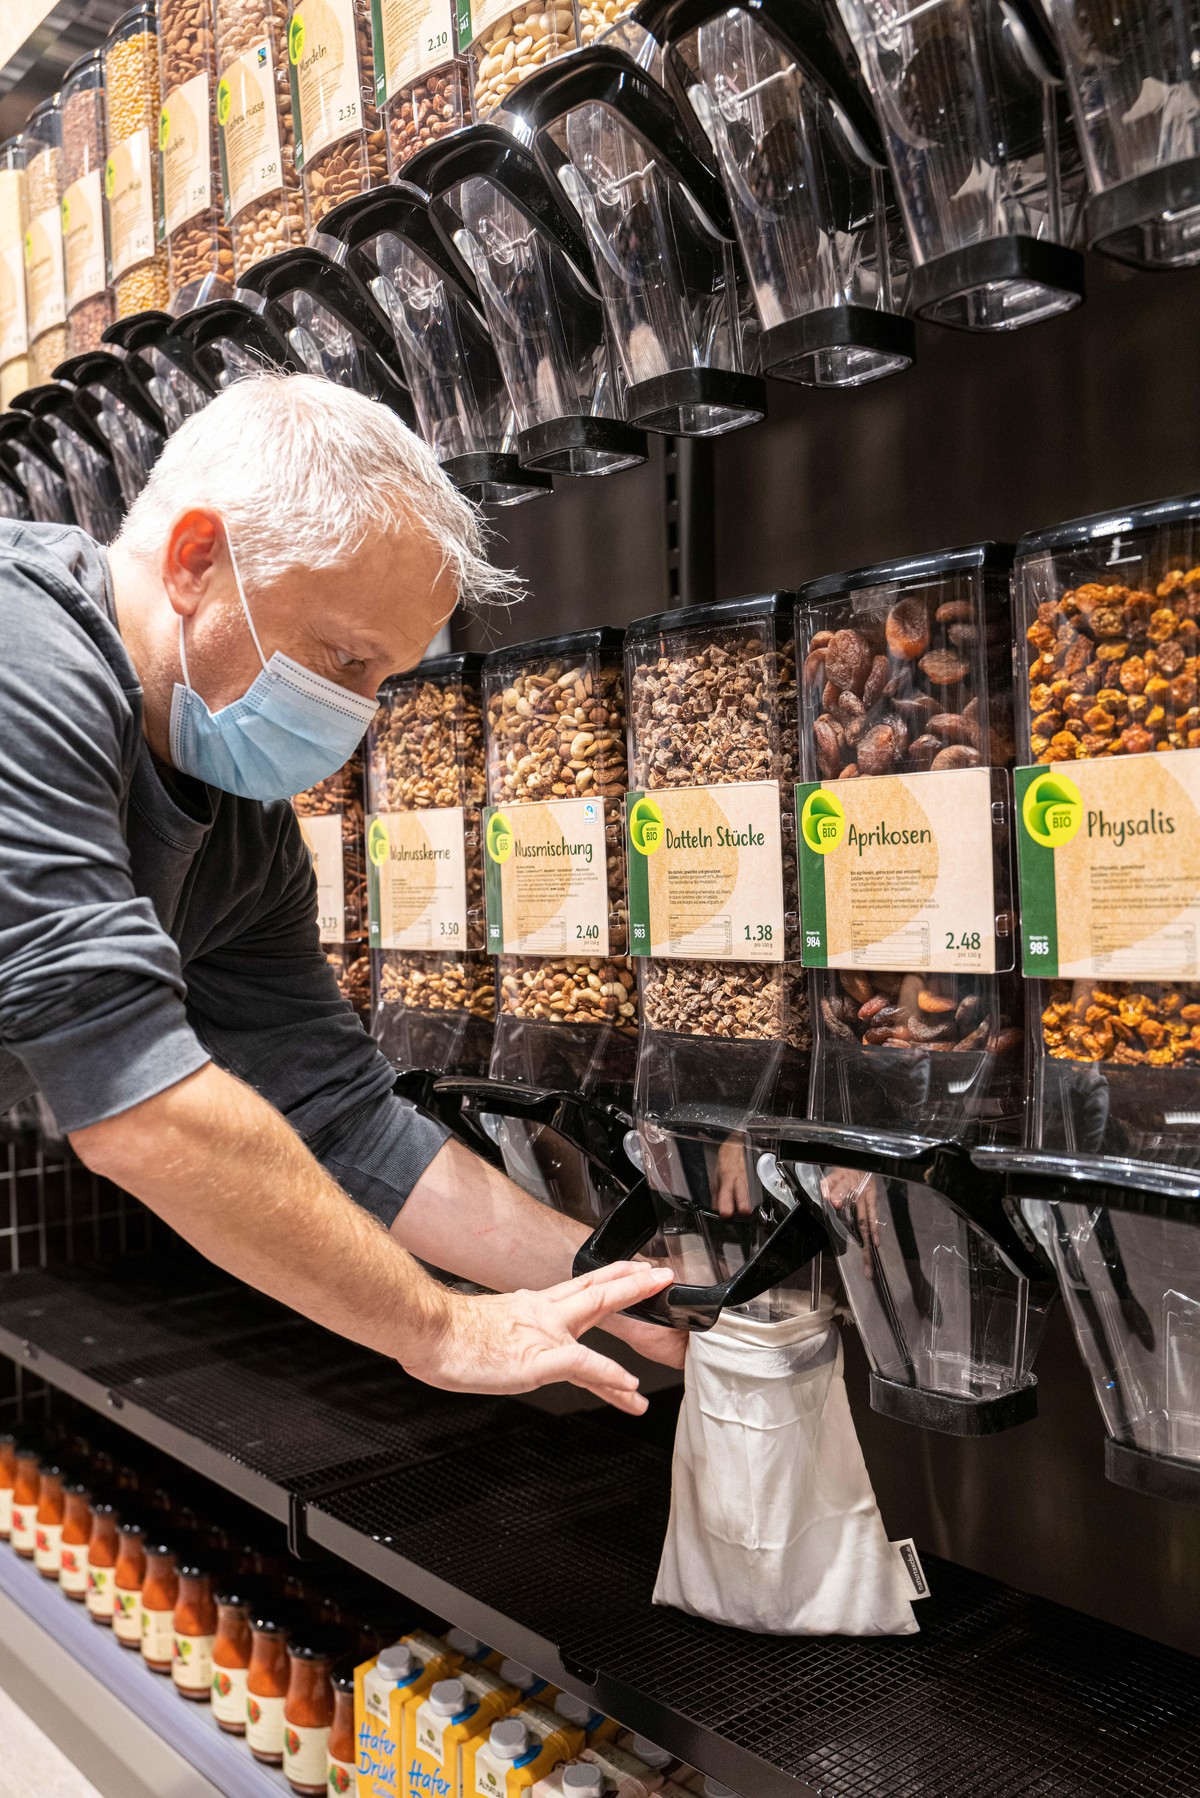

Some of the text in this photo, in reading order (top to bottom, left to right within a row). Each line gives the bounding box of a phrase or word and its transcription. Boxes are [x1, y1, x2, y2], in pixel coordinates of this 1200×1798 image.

[428, 32, 448, 52] 2.10
[300, 44, 326, 75] Mandeln
[338, 103, 356, 121] 2.35
[261, 162, 277, 179] 2.90
[1052, 816, 1071, 828] BIO
[1088, 808, 1176, 846] Physalis
[646, 832, 658, 840] BIO
[666, 824, 764, 849] Datteln Stücke
[822, 827, 836, 838] BIO
[848, 821, 932, 856] Aprikosen
[390, 843, 450, 862] Walnusskerne
[514, 836, 592, 863] Nussmischung
[322, 917, 338, 928] 3.73
[440, 922, 459, 935] 3.50
[576, 925, 599, 939] 2.40
[634, 928, 645, 938] 983
[744, 924, 772, 941] 1.38
[946, 932, 981, 950] 2.48
[806, 936, 820, 947] 984
[1030, 941, 1049, 955] 985
[358, 1722, 396, 1756] Hafer
[357, 1752, 397, 1788] Drink
[408, 1760, 450, 1796] Hafer
